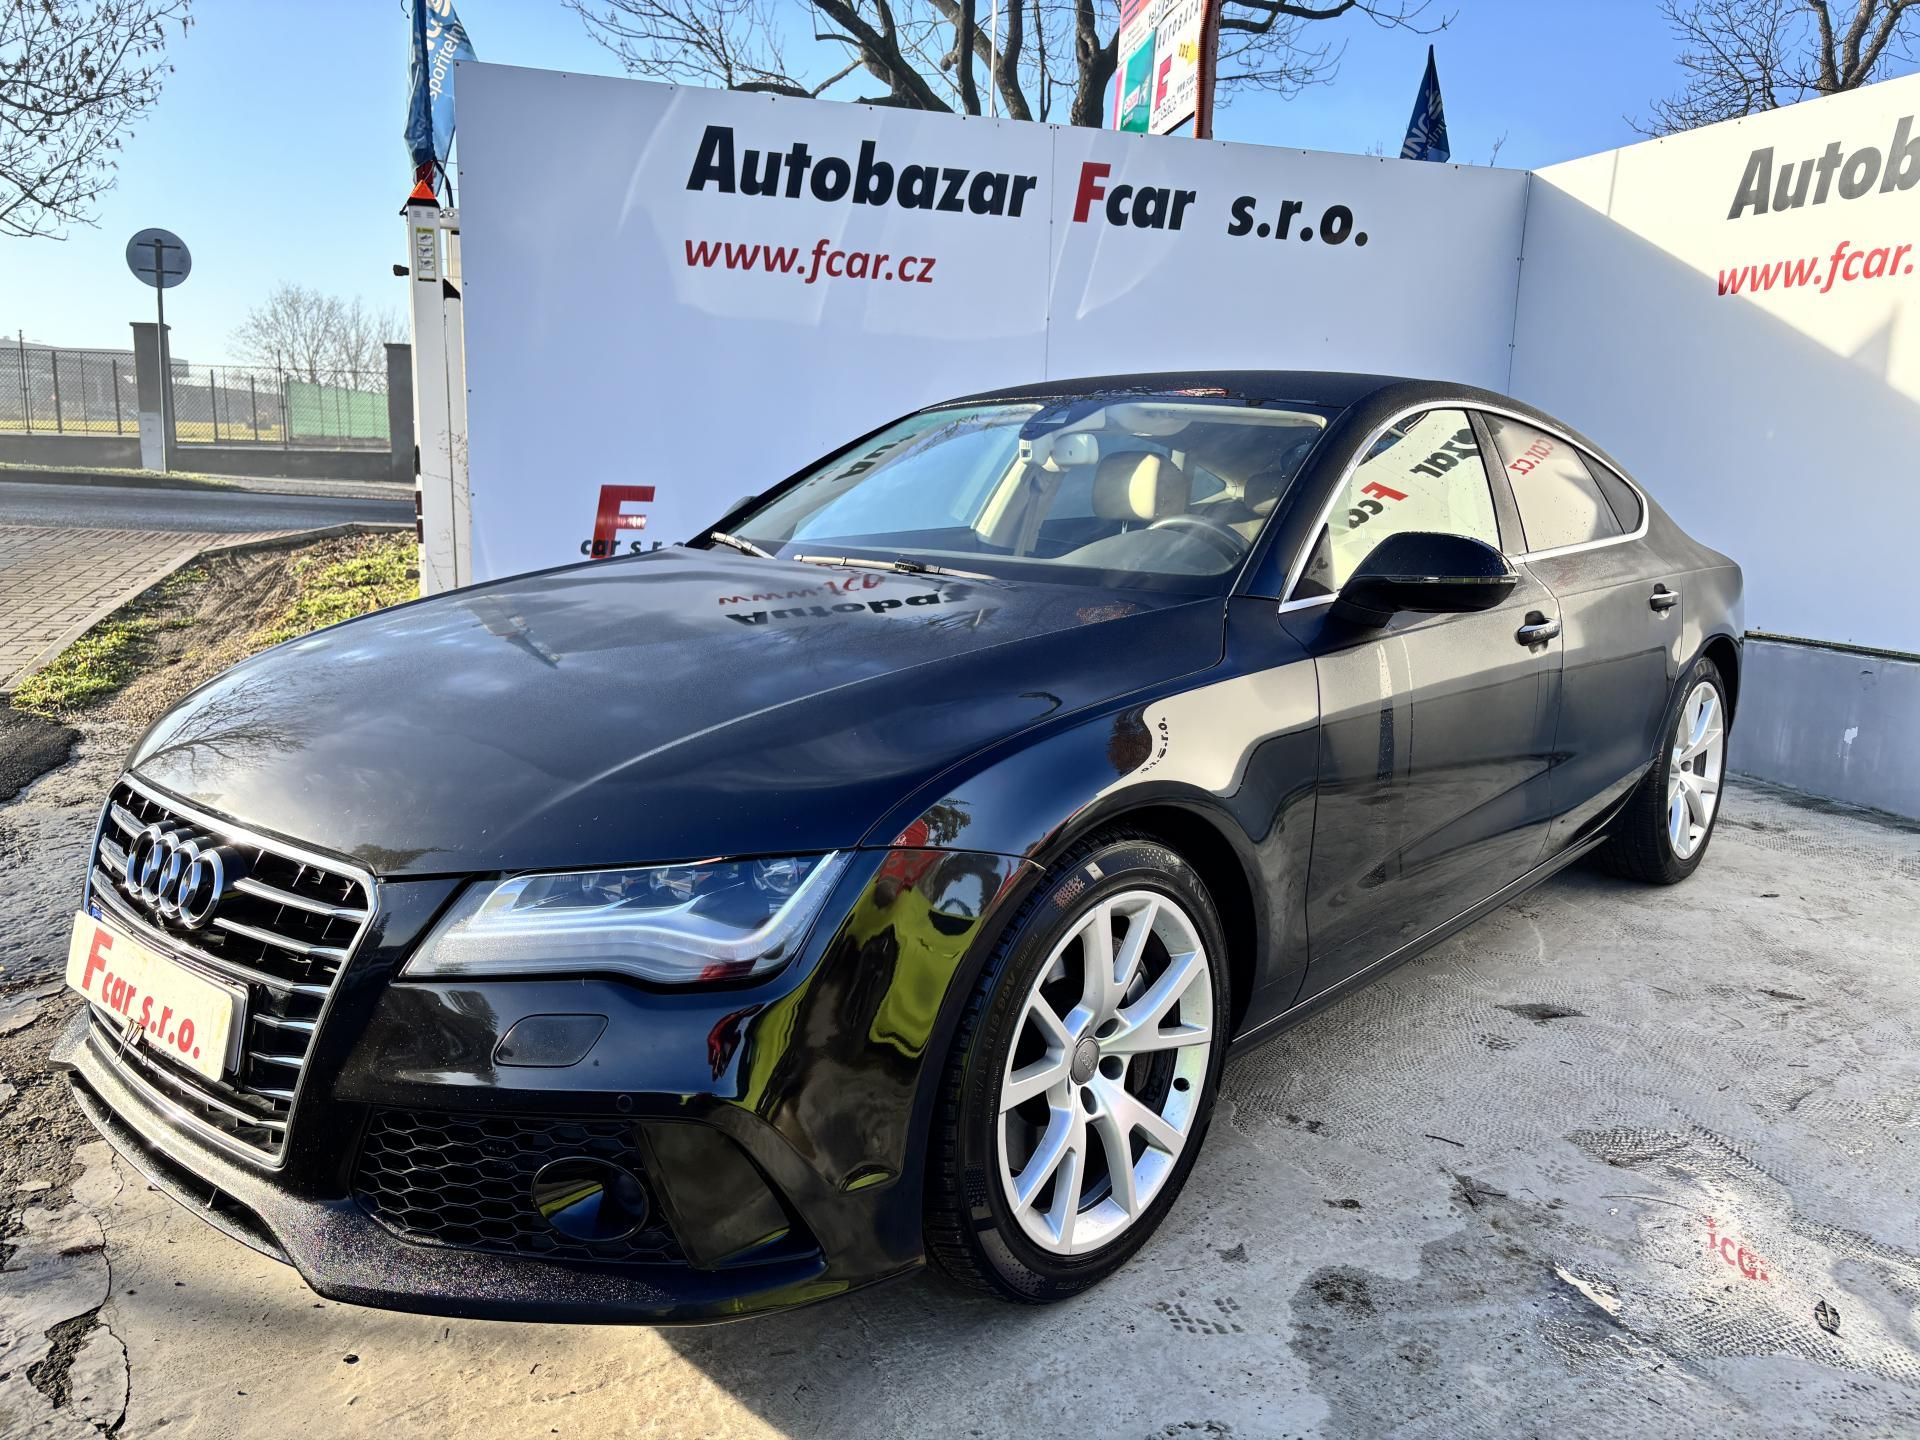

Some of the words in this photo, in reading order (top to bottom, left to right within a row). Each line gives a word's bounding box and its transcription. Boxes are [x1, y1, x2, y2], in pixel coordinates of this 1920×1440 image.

[686, 125, 1037, 217] Autobazar
[1072, 162, 1196, 230] Fcar
[1227, 196, 1368, 247] s.r.o.
[685, 239, 936, 284] www.fcar.cz
[81, 927, 136, 1017] Fcar
[139, 995, 200, 1060] s.r.o.
